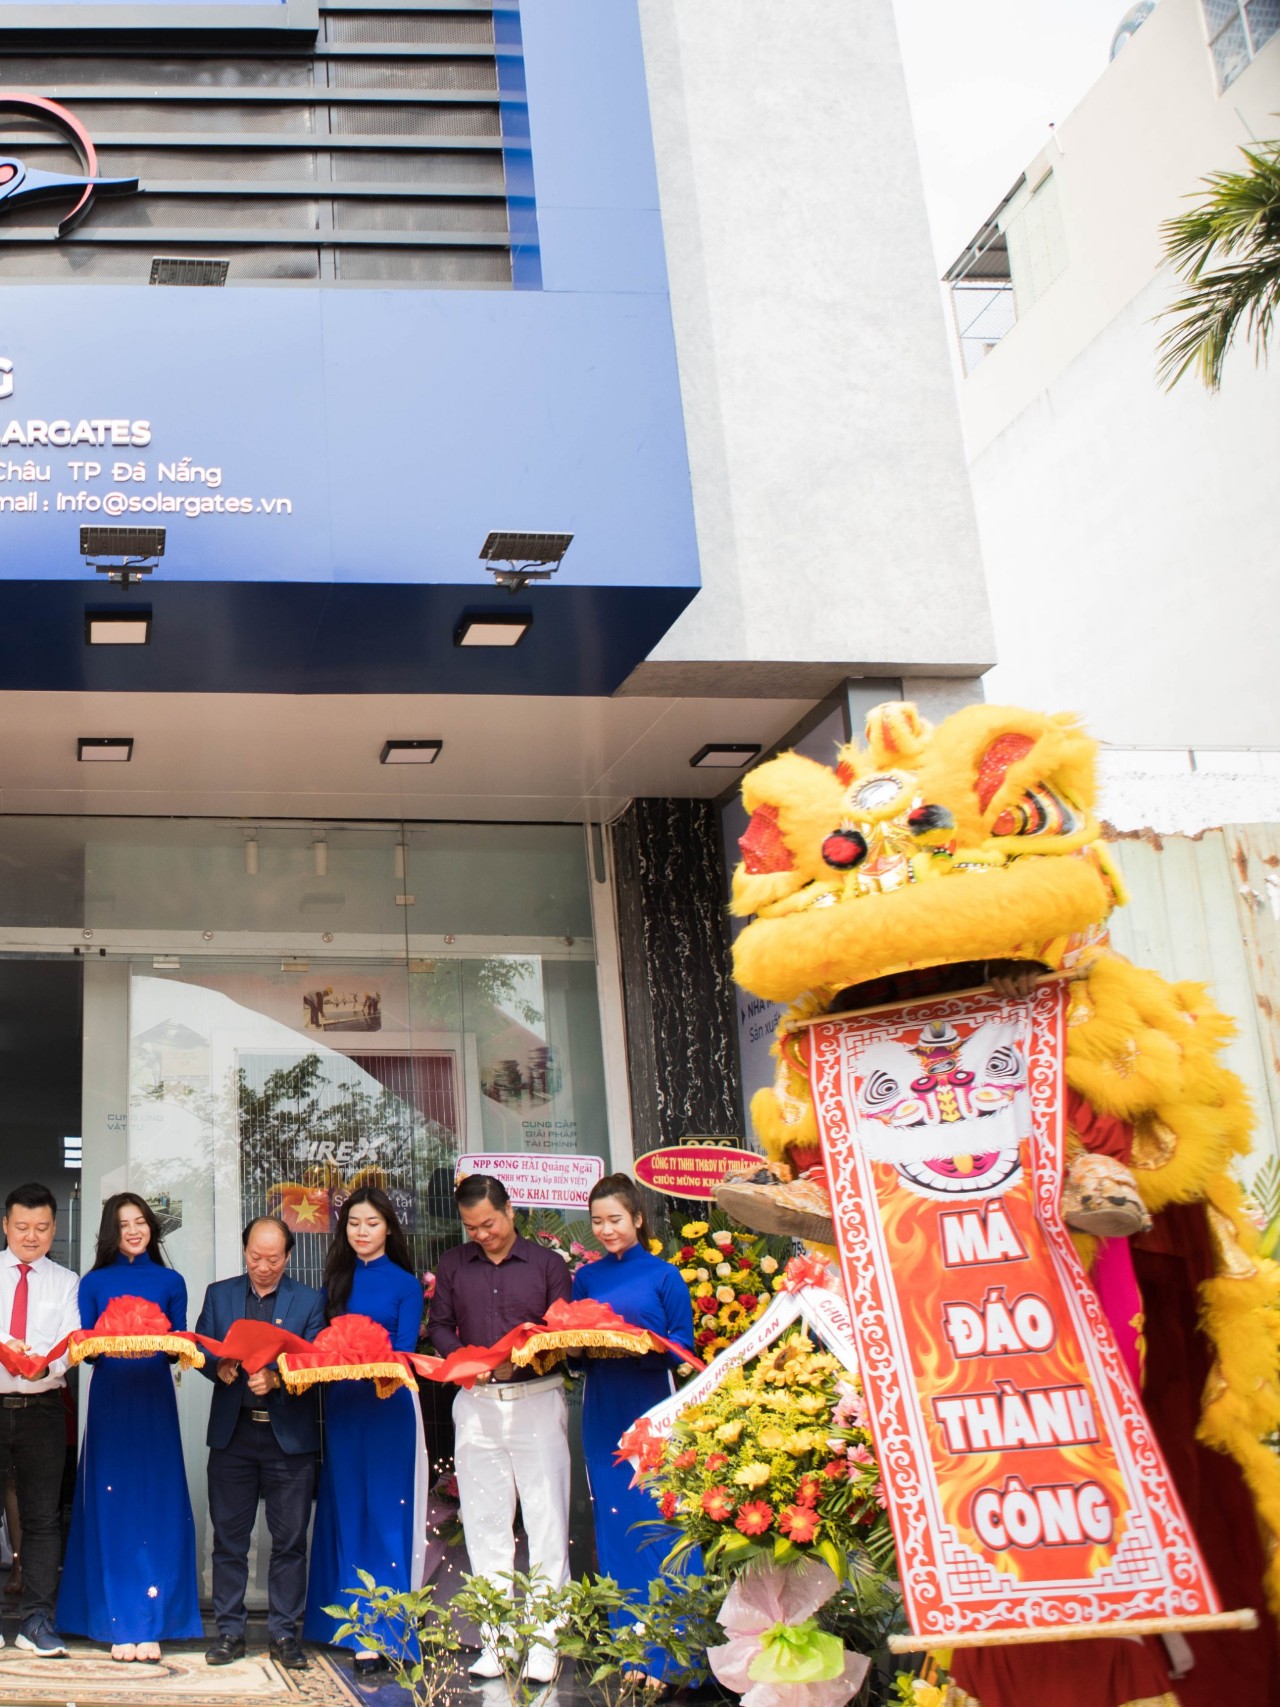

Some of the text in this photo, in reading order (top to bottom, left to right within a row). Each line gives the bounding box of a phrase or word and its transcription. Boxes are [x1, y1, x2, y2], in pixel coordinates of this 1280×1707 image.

[68, 461, 101, 482] TP
[112, 460, 146, 483] Đà
[157, 456, 222, 488] Nẵng
[750, 1023, 764, 1043] Sản
[524, 1138, 577, 1148] TÀI CHÍNH
[472, 1159, 491, 1169] NPP
[493, 1160, 519, 1170] SONG
[651, 1153, 669, 1170] CÔNG
[669, 1156, 677, 1170] TY
[677, 1156, 695, 1171] TNHH
[652, 1173, 675, 1186] CHÚC
[676, 1175, 701, 1187] MỪNG
[395, 1195, 413, 1211] tại
[505, 1184, 589, 1202] ỪNG KHAI TRƯƠNG
[943, 1202, 1024, 1264] MÁ
[820, 1299, 851, 1331] CHÚC
[948, 1291, 1054, 1355] ĐÁO
[758, 1318, 781, 1343] LAN
[936, 1384, 1099, 1450] THÀNH
[974, 1480, 1112, 1548] CÔNG
